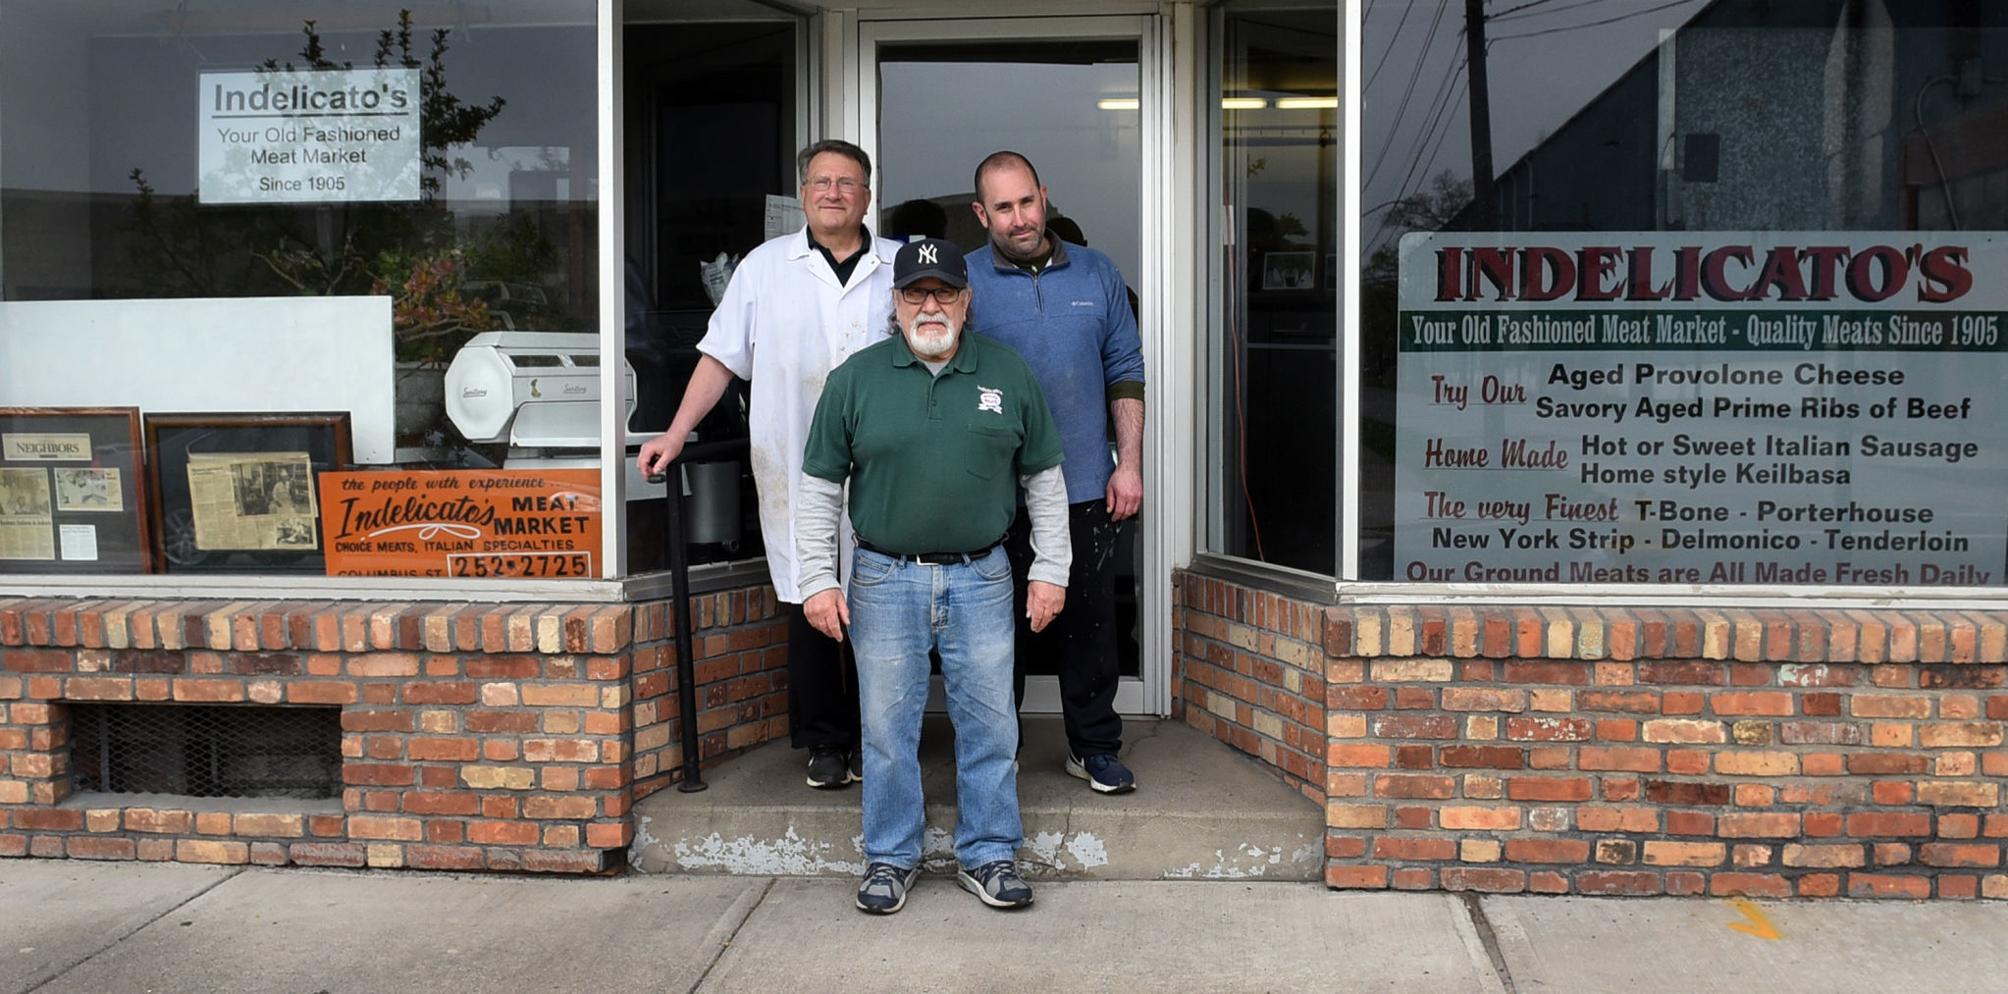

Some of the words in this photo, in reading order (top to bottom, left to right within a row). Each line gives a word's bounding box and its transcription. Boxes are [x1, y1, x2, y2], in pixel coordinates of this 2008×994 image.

[214, 83, 408, 111] Indelicato's
[217, 129, 259, 143] Your
[265, 127, 296, 143] Old
[303, 126, 400, 142] Fashioned
[251, 149, 296, 164] Meat
[303, 148, 367, 164] Market
[259, 177, 301, 191] Since
[308, 177, 345, 191] 1905
[1433, 243, 1973, 303] INDELICATO'S
[1412, 315, 1457, 345] Your
[1461, 314, 1491, 345] Old
[1496, 314, 1596, 344] Fashioned
[1602, 315, 1650, 344] Meat
[1656, 315, 1727, 345] Market
[1746, 314, 1817, 350] Quality
[1822, 316, 1883, 345] Meats
[1888, 315, 1943, 345] Since
[1949, 315, 1998, 346] 1905
[1548, 363, 1624, 390] Aged
[1635, 363, 1783, 385] Provolone
[1794, 363, 1905, 385] Cheese
[1431, 375, 1468, 411] Try
[1481, 375, 1527, 404] Our
[1536, 396, 1627, 423] Savory
[1635, 397, 1704, 423] Aged
[1713, 397, 1792, 419] Prime
[1800, 397, 1860, 419] Ribs
[1869, 397, 1897, 419] of
[1907, 397, 1971, 419] Beef
[16, 442, 80, 454] NEIGHBORS
[1425, 438, 1489, 468] Home
[1501, 438, 1568, 469] Made
[1582, 435, 1627, 456] Hot
[1637, 440, 1664, 456] or
[1673, 434, 1756, 456] Sweet
[1766, 435, 1850, 456] Italian
[1860, 434, 1979, 463] Sausage
[341, 479, 365, 491] the
[371, 477, 417, 493] people
[426, 477, 459, 489] with
[1581, 463, 1654, 484] Home
[1664, 463, 1727, 489] style
[1736, 463, 1851, 484] Keilbasa
[335, 494, 495, 539] Indelicato's
[512, 495, 579, 512] MEAT
[1424, 491, 1466, 518] The
[1478, 500, 1530, 526] very
[1545, 493, 1620, 521] Finest
[1635, 500, 1729, 521] T-Bone
[1757, 500, 1934, 522] Porterhouse
[495, 516, 589, 535] MARKET
[335, 541, 373, 553] CHOICE
[377, 541, 418, 554] MEATS,
[424, 540, 474, 552] ITALIAN
[483, 539, 574, 552] SPECIALTIES
[1432, 528, 1490, 549] New
[1500, 528, 1559, 549] York
[1569, 528, 1634, 554] Strip
[1661, 528, 1800, 550] Delmonico
[1824, 529, 1969, 552] Tenderloin
[1407, 561, 1455, 582] Our
[1464, 561, 1560, 582] Ground
[1570, 562, 1649, 583] Meats
[1658, 568, 1700, 583] are
[1708, 561, 1745, 583] All
[1755, 562, 1827, 583] Made
[1836, 562, 1909, 584] Fresh
[1920, 564, 1991, 584] Daily
